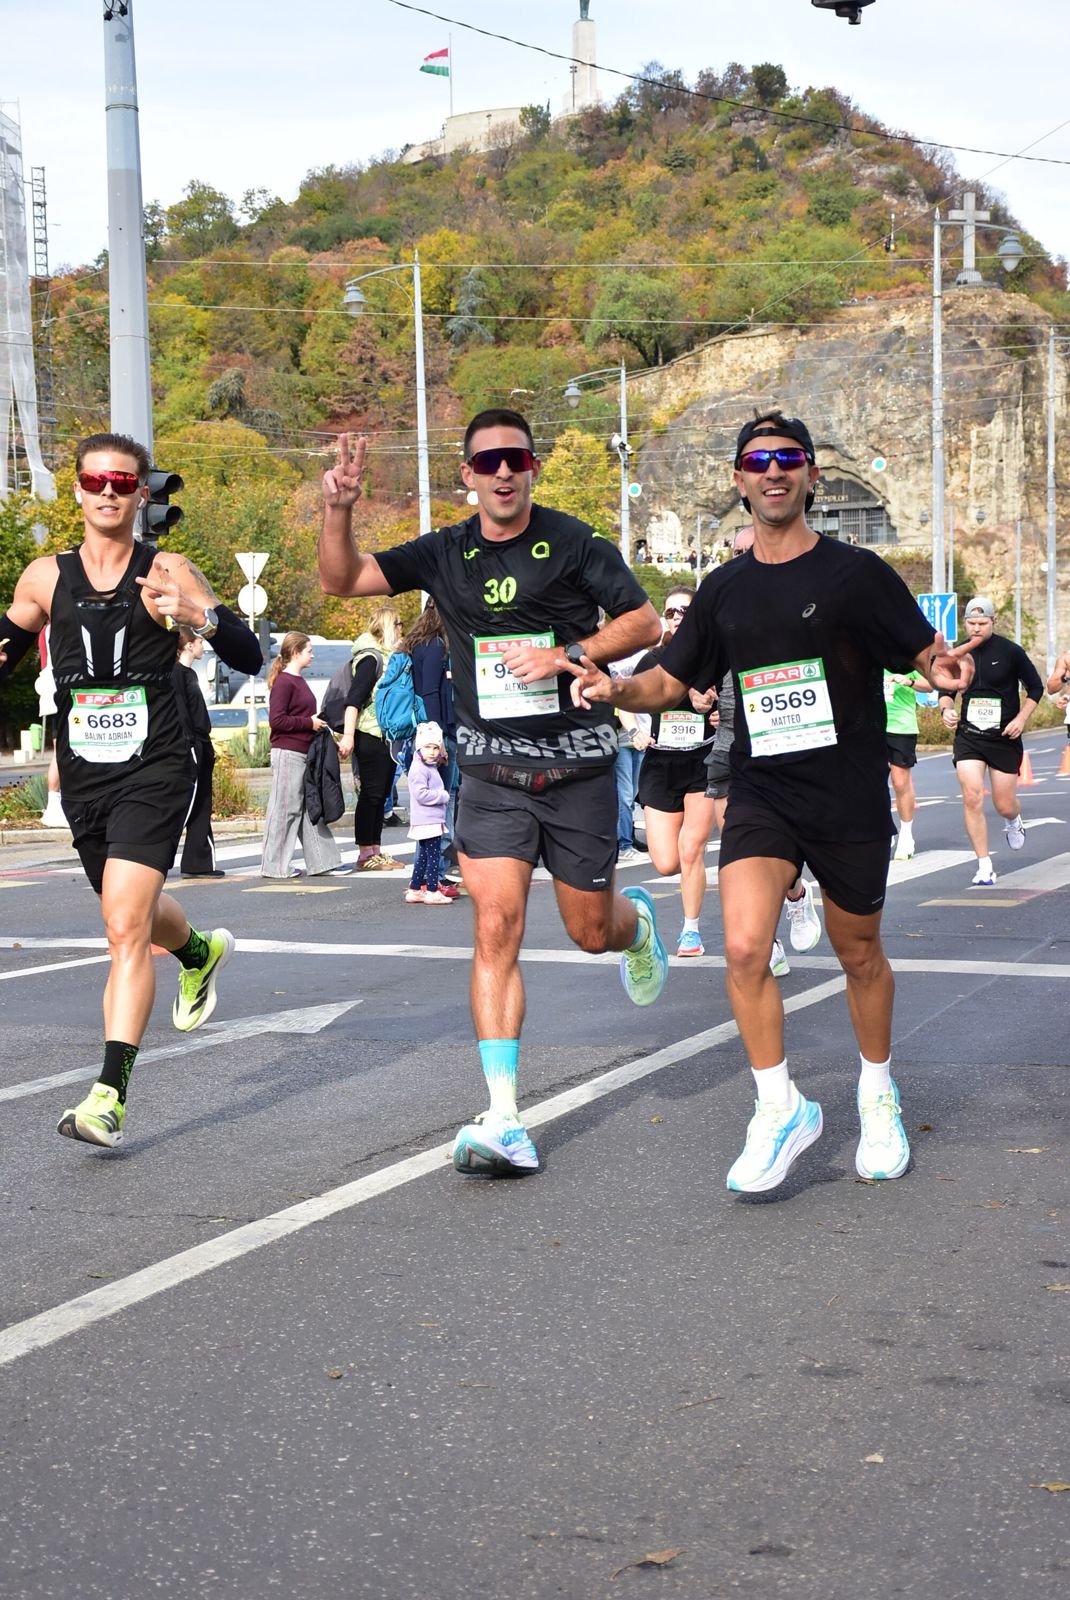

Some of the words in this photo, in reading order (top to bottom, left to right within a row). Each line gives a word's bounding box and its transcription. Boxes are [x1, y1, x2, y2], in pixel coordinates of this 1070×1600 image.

[483, 576, 517, 605] 30
[481, 668, 486, 676] 1
[752, 668, 800, 686] SPAR
[504, 682, 528, 692] ALEXIS
[84, 693, 124, 704] SPAR
[749, 703, 756, 713] 2
[761, 689, 817, 713] 9569
[977, 708, 994, 717] 628
[73, 716, 81, 724] 2
[87, 712, 138, 729] 6683
[771, 714, 801, 727] MATTEO
[671, 725, 697, 735] 3916
[84, 732, 106, 741] BALINT
[108, 731, 133, 741] ADRIAN
